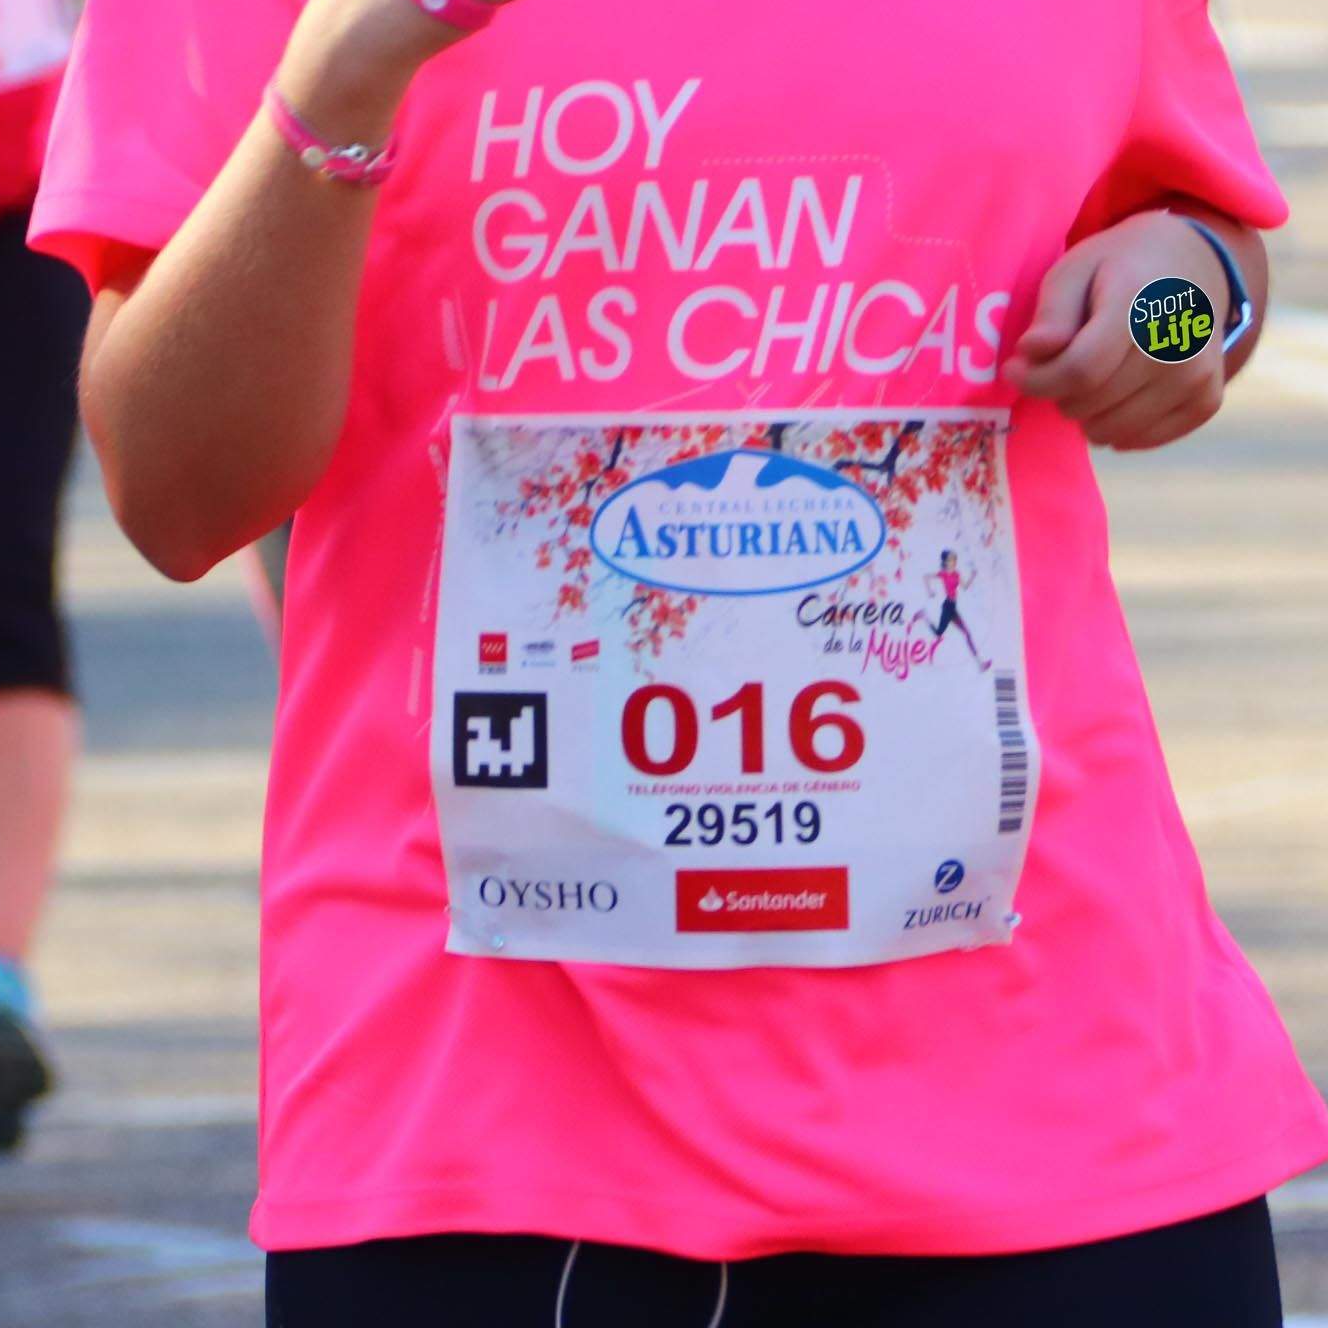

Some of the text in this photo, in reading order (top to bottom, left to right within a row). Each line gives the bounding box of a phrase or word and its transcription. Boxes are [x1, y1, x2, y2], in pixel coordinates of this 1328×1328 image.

[470, 77, 703, 183] HOY
[471, 174, 863, 284] GANAN
[477, 278, 1011, 391] LAS CHICAS
[657, 498, 754, 515] CENTRAL
[613, 504, 866, 559] ASTURIANA
[796, 593, 905, 628] Carrera
[824, 626, 944, 681] de la Mujer
[620, 679, 866, 777] 016
[782, 781, 800, 793] DE
[663, 800, 822, 847] 29519
[478, 875, 619, 913] OYSHO
[726, 889, 828, 912] Santander
[904, 900, 983, 930] ZURICH
